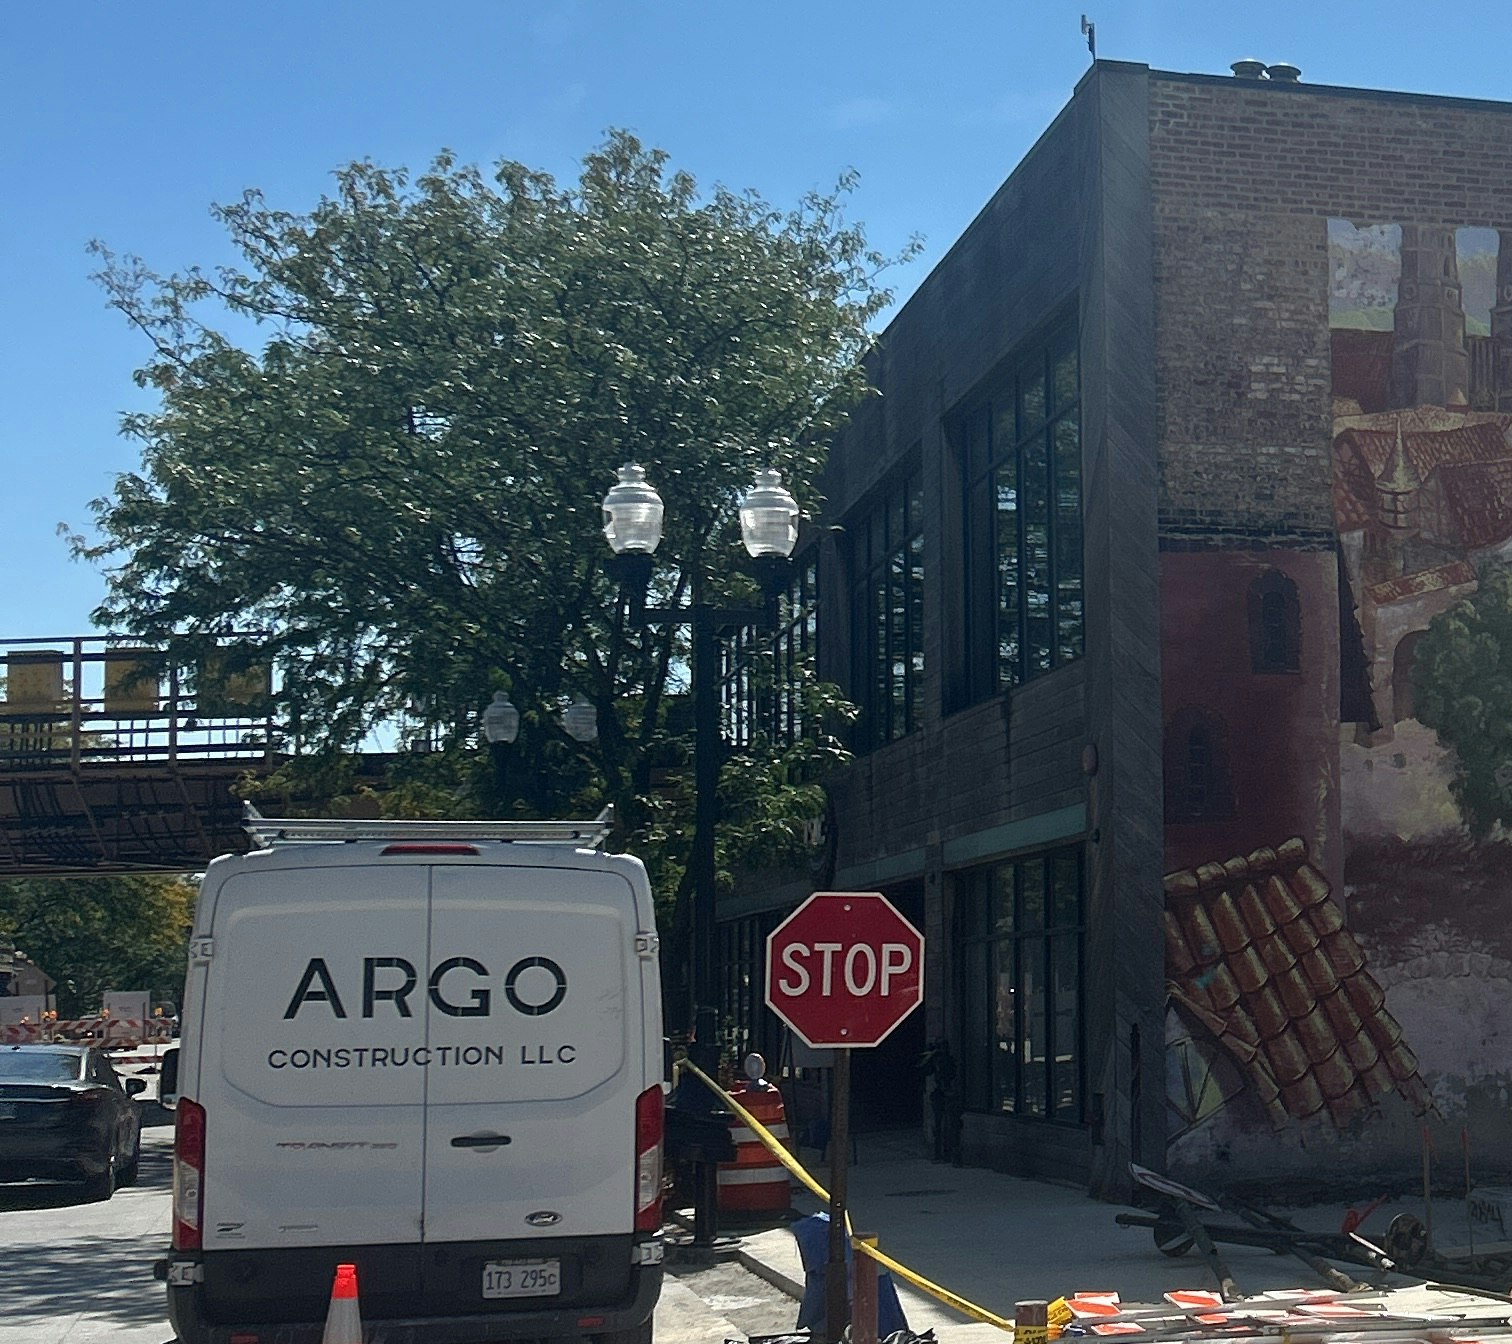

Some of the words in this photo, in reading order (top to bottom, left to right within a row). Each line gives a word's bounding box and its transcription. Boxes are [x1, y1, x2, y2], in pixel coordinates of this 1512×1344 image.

[283, 956, 567, 1019] ARGO
[779, 942, 912, 997] STOP
[268, 1046, 503, 1070] CONSTRUCTION
[521, 1045, 577, 1065] LLC
[485, 1270, 513, 1291] 173
